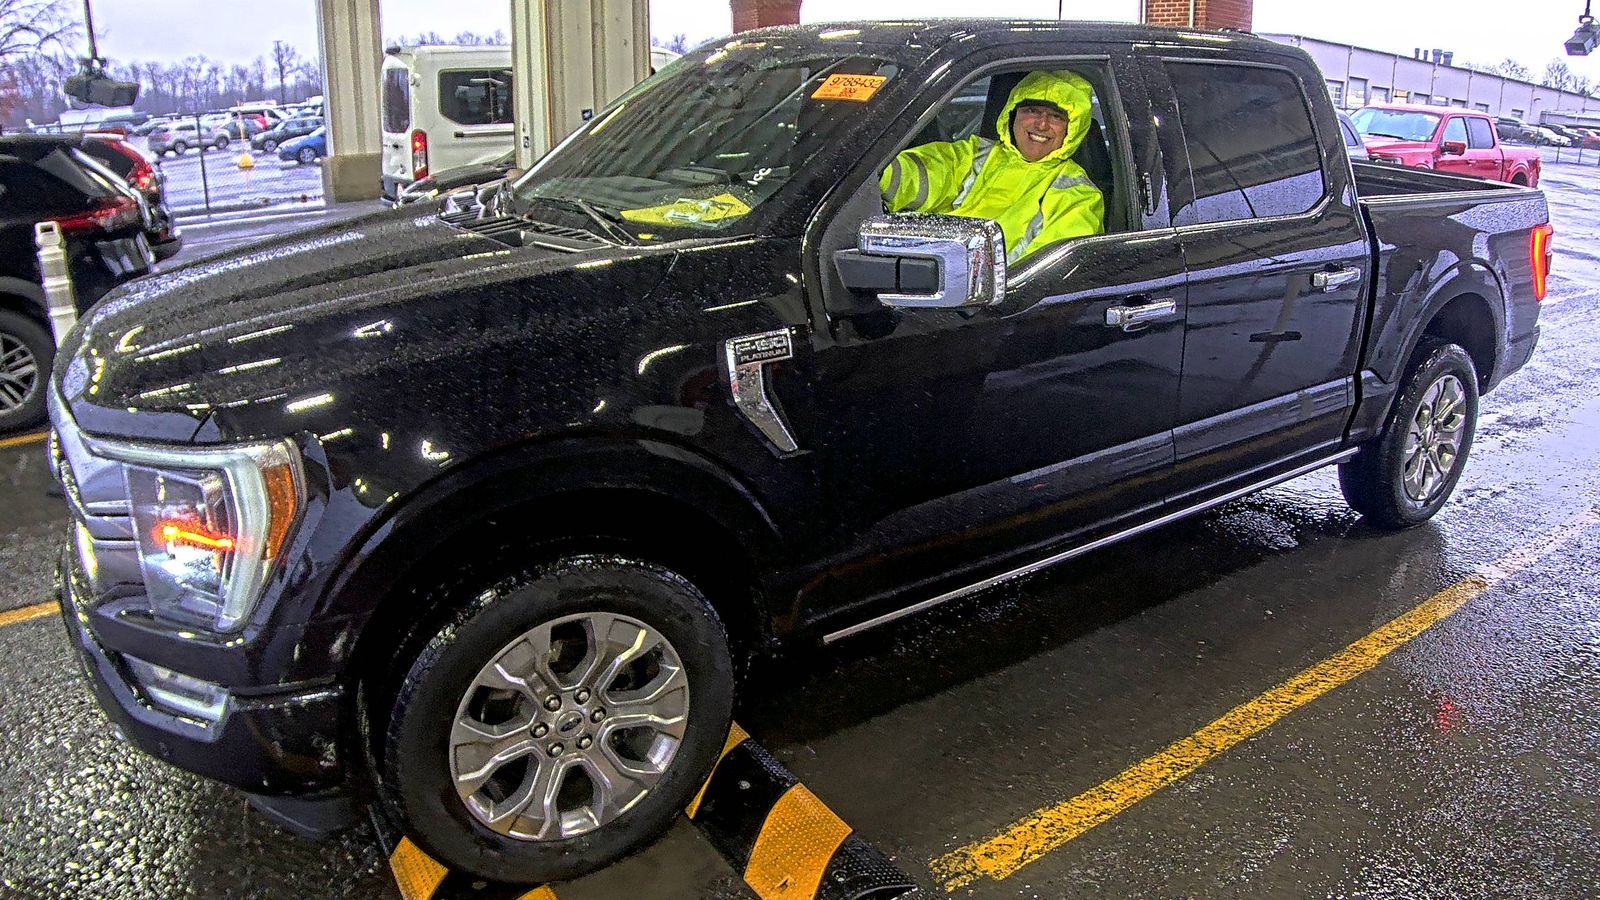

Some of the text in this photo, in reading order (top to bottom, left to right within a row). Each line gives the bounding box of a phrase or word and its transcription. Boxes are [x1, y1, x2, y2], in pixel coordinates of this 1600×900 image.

[829, 76, 883, 88] 9788432
[735, 335, 788, 354] F-150
[740, 348, 787, 362] PLATINUM
